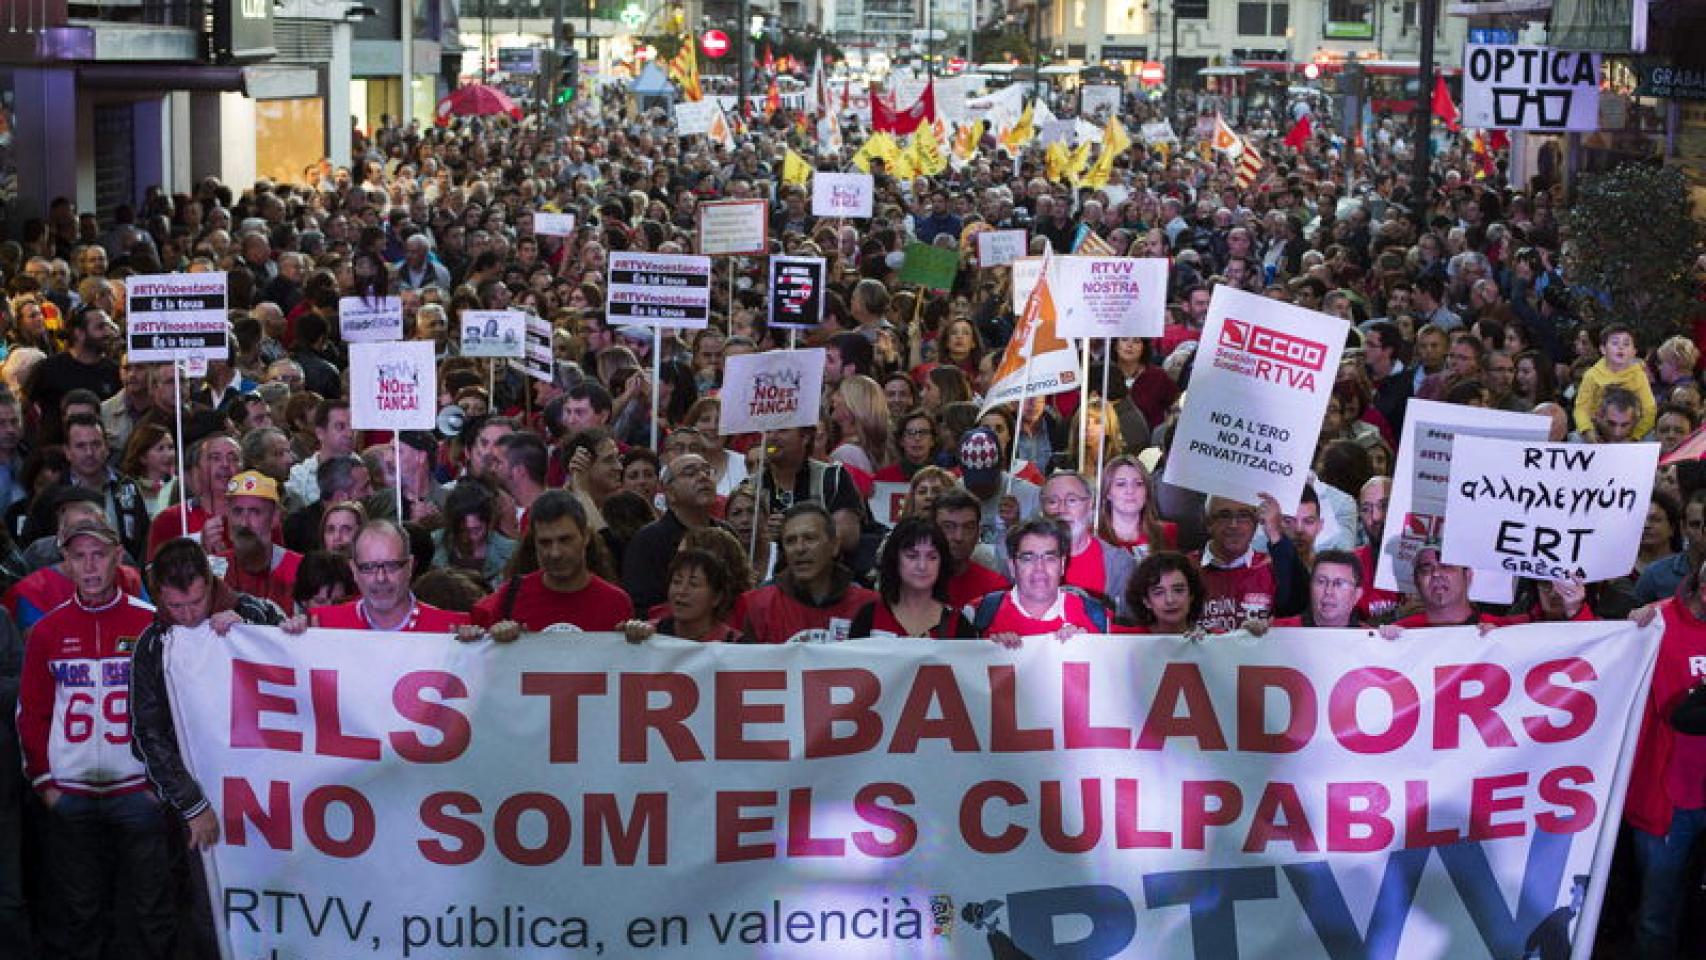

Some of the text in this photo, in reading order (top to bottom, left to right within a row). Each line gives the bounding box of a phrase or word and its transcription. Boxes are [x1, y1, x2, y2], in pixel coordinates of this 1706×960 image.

[1470, 48, 1596, 86] OPTICA
[1091, 262, 1134, 273] RTVV
[1082, 281, 1139, 293] NOSTRA
[1255, 333, 1322, 367] CCOO
[1255, 360, 1316, 394] RTVA
[1211, 411, 1291, 442] NO A L'ERO
[1217, 430, 1273, 455] NO A LA
[1420, 450, 1451, 462] #RTV
[1495, 520, 1596, 564] ERT
[64, 691, 133, 745] 69
[230, 657, 1599, 764] ELS TREBALLADORS
[222, 765, 1599, 867] NO SOM ELS CULPABLES
[224, 887, 380, 951] RTVV,
[402, 904, 604, 957] pública,
[626, 913, 688, 948] en
[709, 896, 922, 945] valencià
